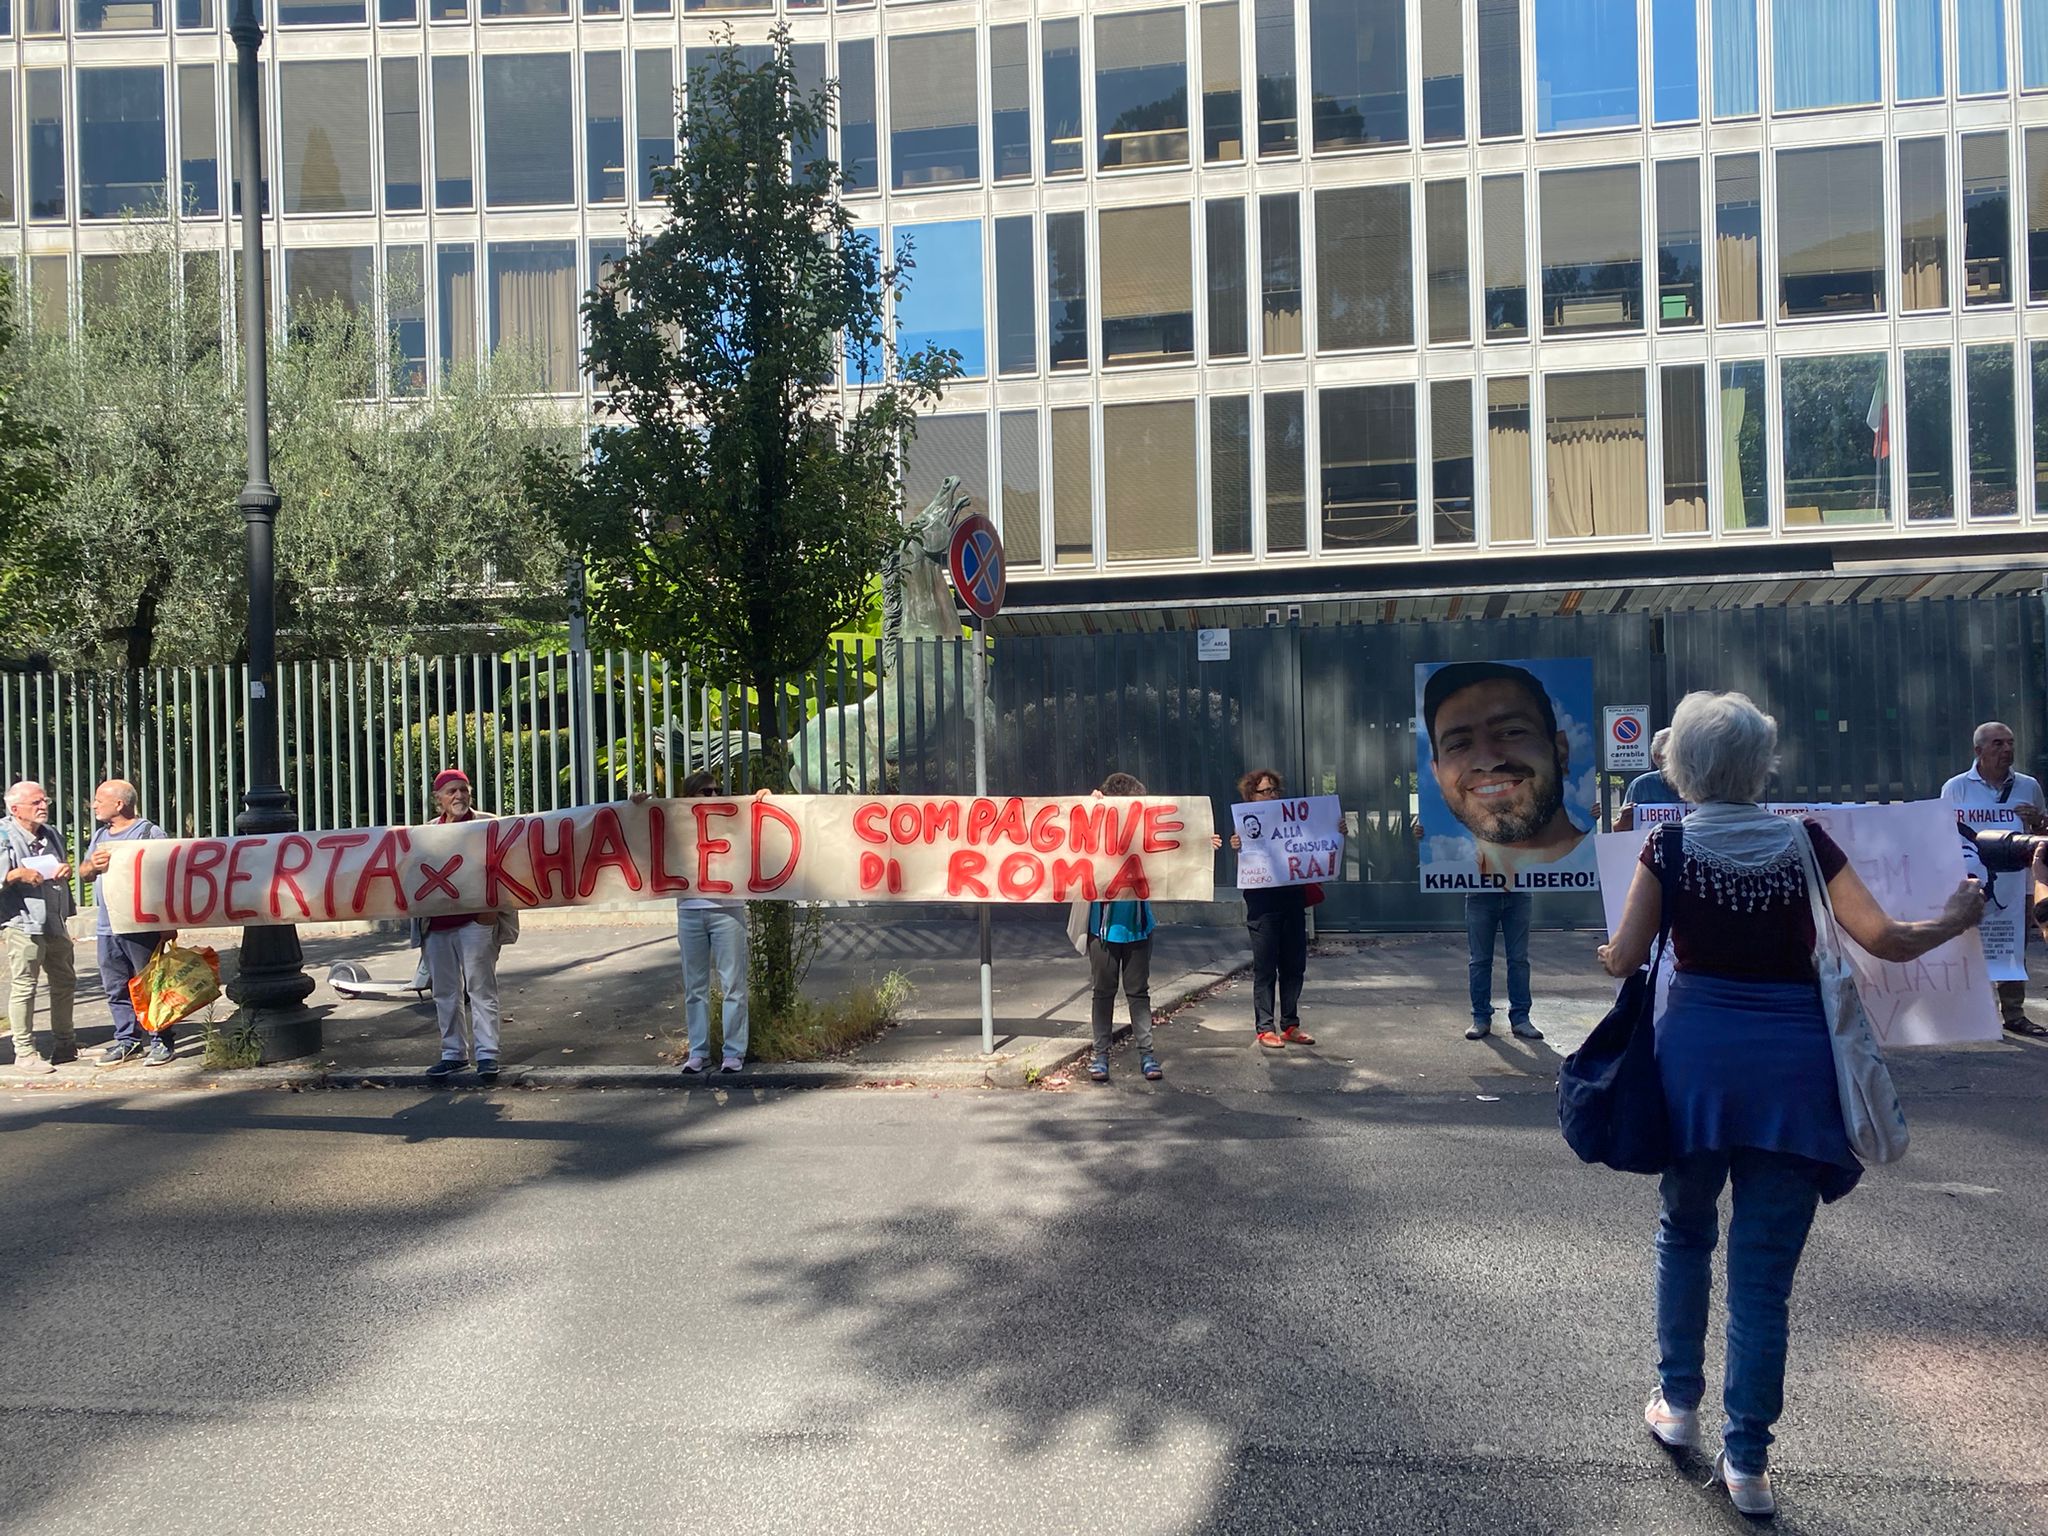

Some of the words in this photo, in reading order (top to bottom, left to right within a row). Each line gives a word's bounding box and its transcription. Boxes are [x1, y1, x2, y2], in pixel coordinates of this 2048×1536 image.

[1281, 801, 1309, 822] NO
[1640, 806, 1682, 821] LIBERTÀ
[1968, 809, 2015, 823] KHALED
[1271, 824, 1303, 840] ALLA
[485, 801, 802, 908] KHALED
[1284, 839, 1339, 853] CENSURA
[859, 851, 902, 894] DI
[946, 849, 1150, 902] ROMA
[1425, 873, 1507, 889] KHALED
[1514, 871, 1595, 888] LIBERO!
